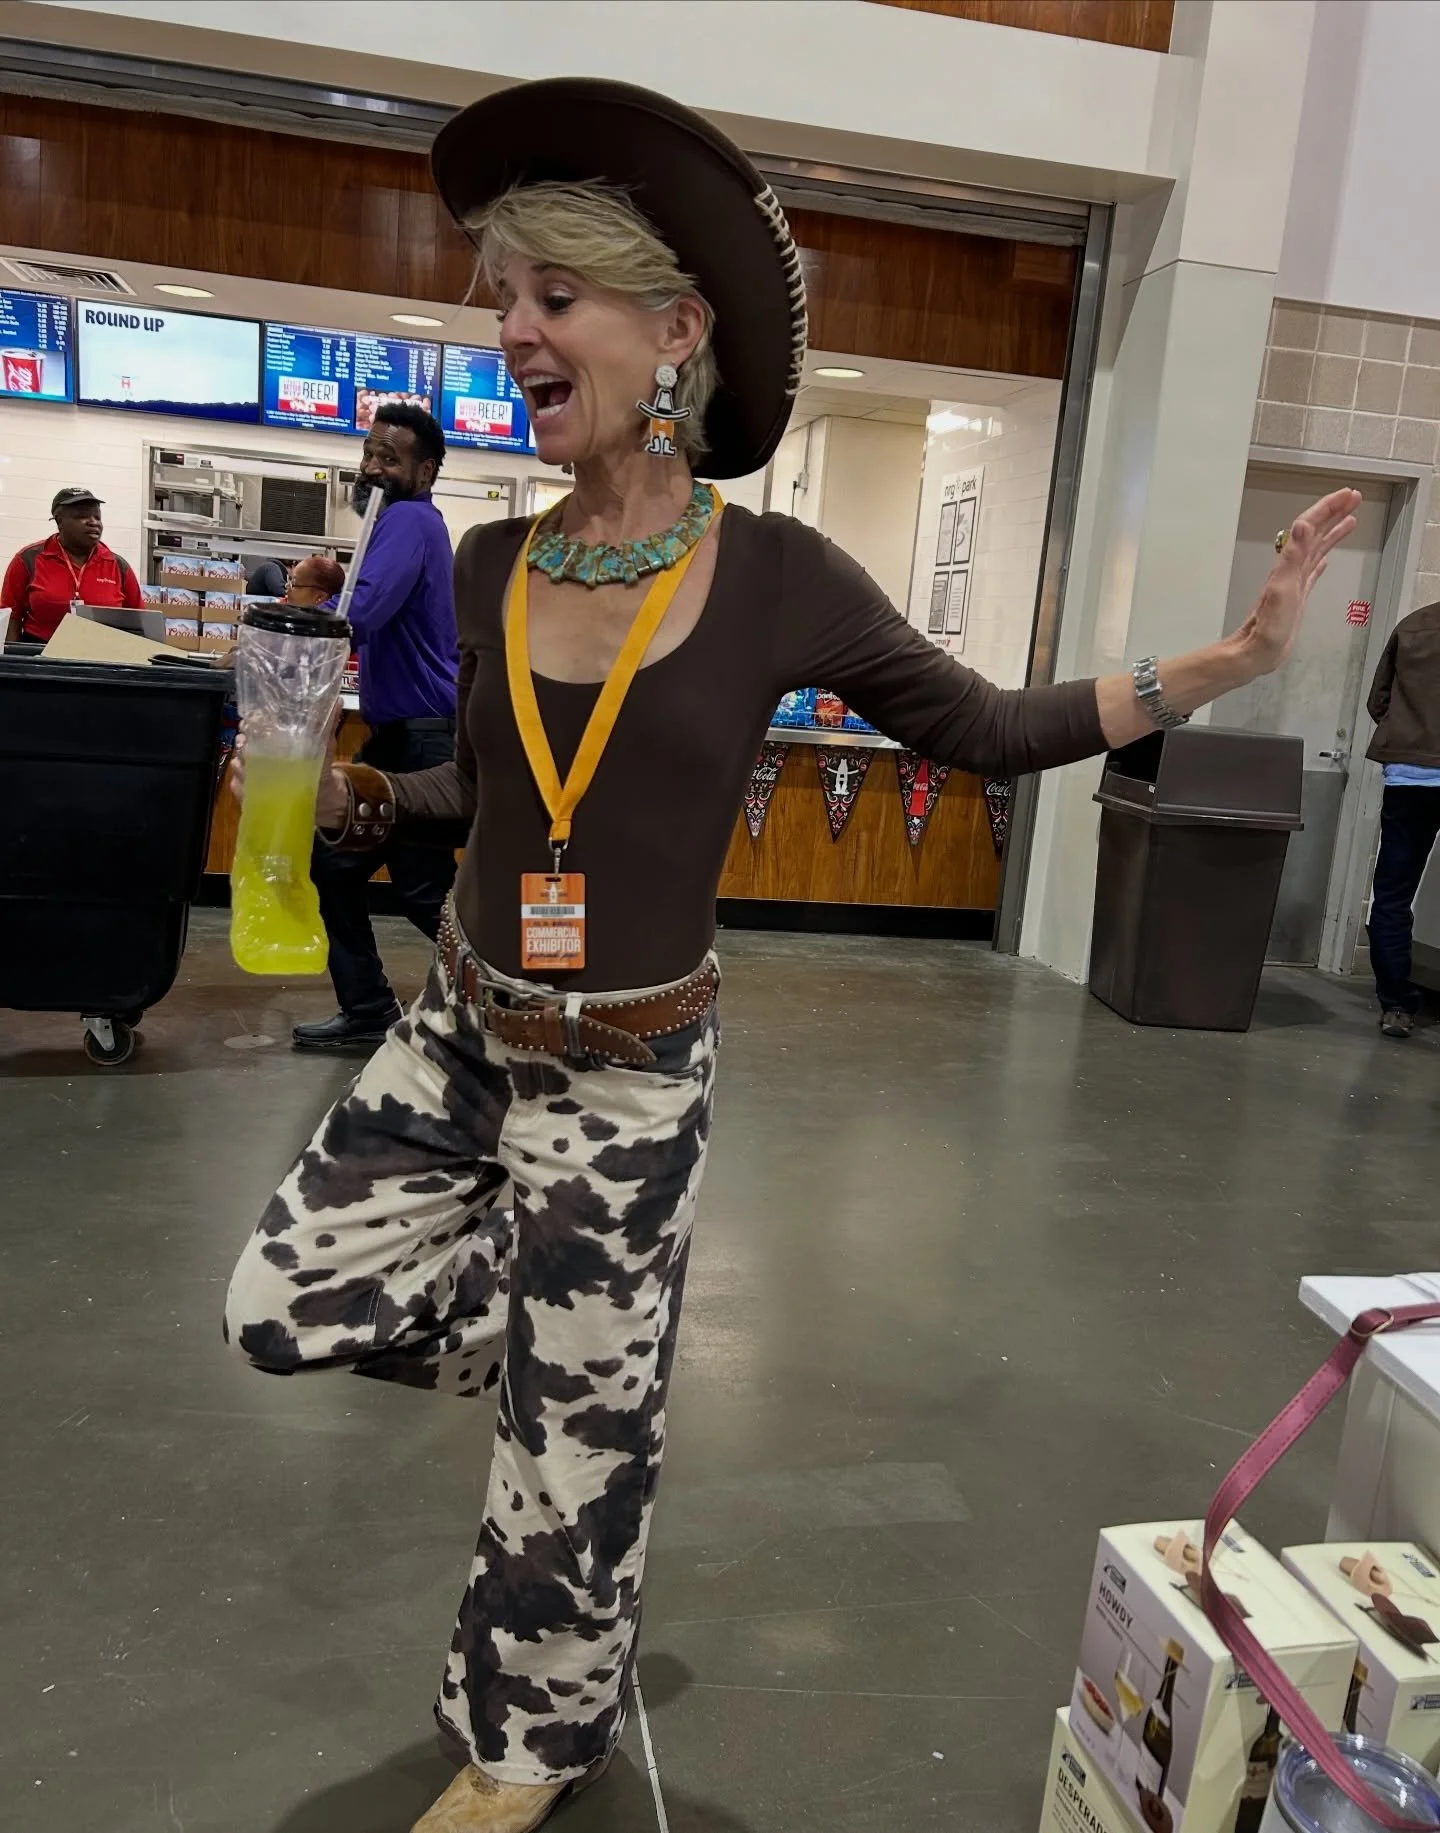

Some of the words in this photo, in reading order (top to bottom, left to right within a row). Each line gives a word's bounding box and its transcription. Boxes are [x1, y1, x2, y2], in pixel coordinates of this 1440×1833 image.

[85, 309, 140, 330] ROUND
[144, 314, 164, 332] UP
[302, 381, 335, 401] BEER!
[478, 401, 509, 420] BEER!
[526, 927, 580, 938] COMMERCIAL
[526, 938, 581, 953] EXHIBITOR
[1099, 1581, 1134, 1629] HOWDY
[1057, 1767, 1107, 1833] DESPERAD
